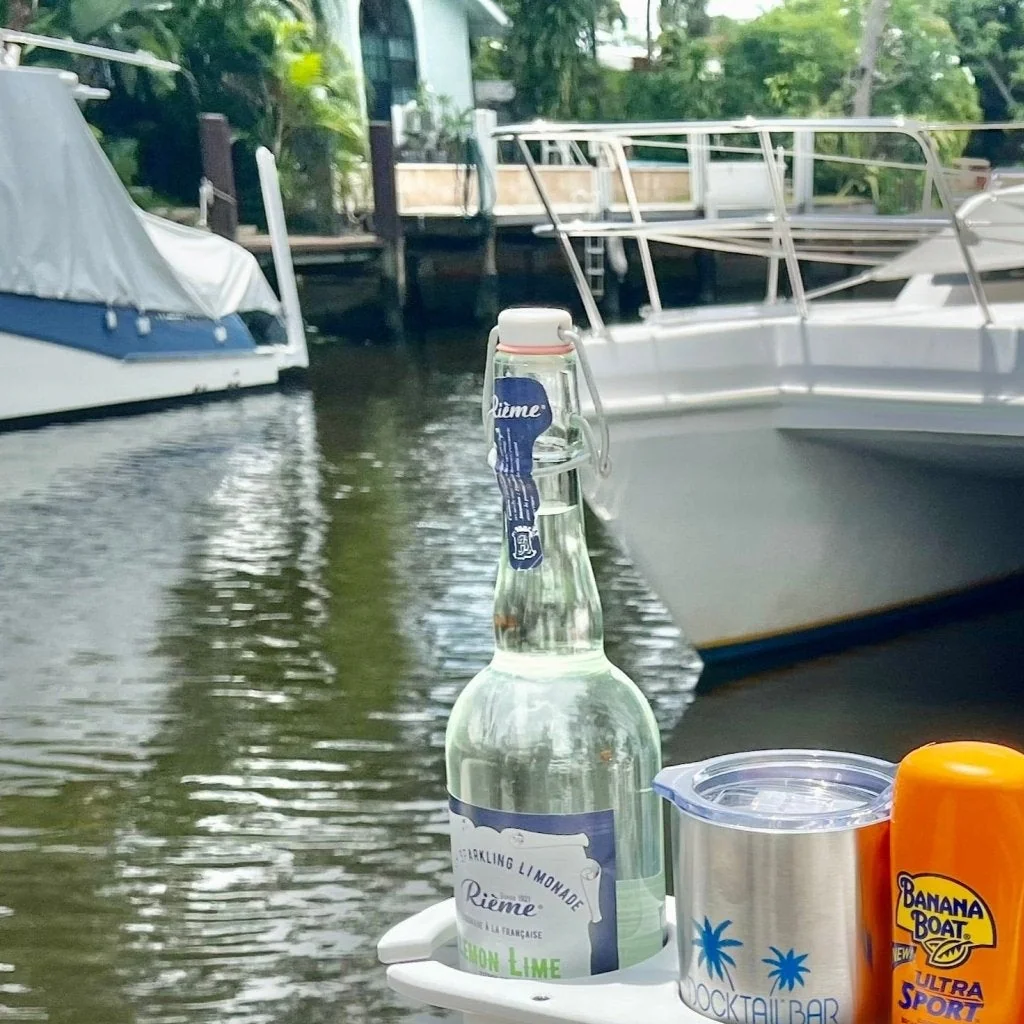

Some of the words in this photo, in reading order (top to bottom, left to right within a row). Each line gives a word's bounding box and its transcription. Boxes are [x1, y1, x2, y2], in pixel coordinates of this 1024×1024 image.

[461, 878, 537, 917] Rième
[518, 861, 584, 912] LIMONADE
[900, 876, 984, 919] BANANA
[502, 927, 543, 940] FRANÇAISE
[911, 910, 968, 940] BOAT
[508, 946, 561, 978] LIME
[898, 980, 984, 1022] SPORT
[916, 970, 984, 1000] ULTRA
